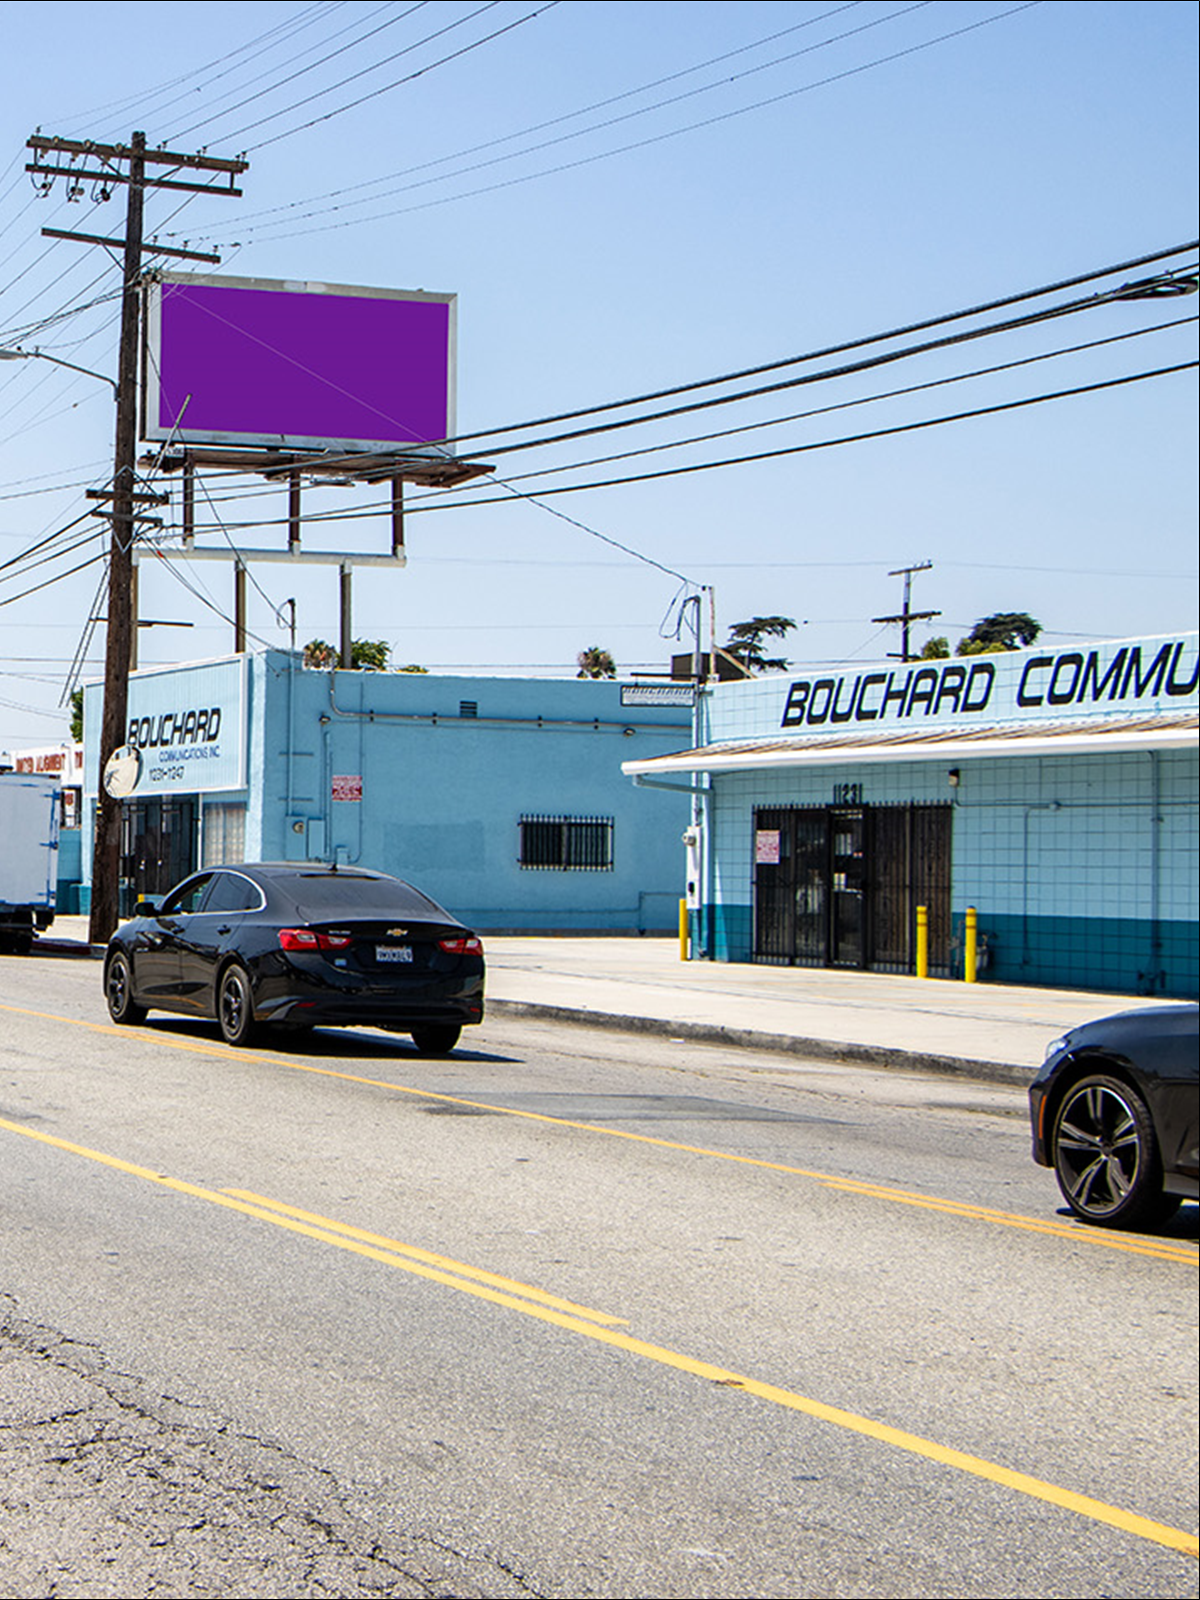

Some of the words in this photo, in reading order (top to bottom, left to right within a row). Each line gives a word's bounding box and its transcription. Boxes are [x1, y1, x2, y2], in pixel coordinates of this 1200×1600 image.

[782, 663, 995, 727] BOUCHARD
[1017, 641, 1198, 706] COMMU
[128, 707, 221, 749] BOUCHARD
